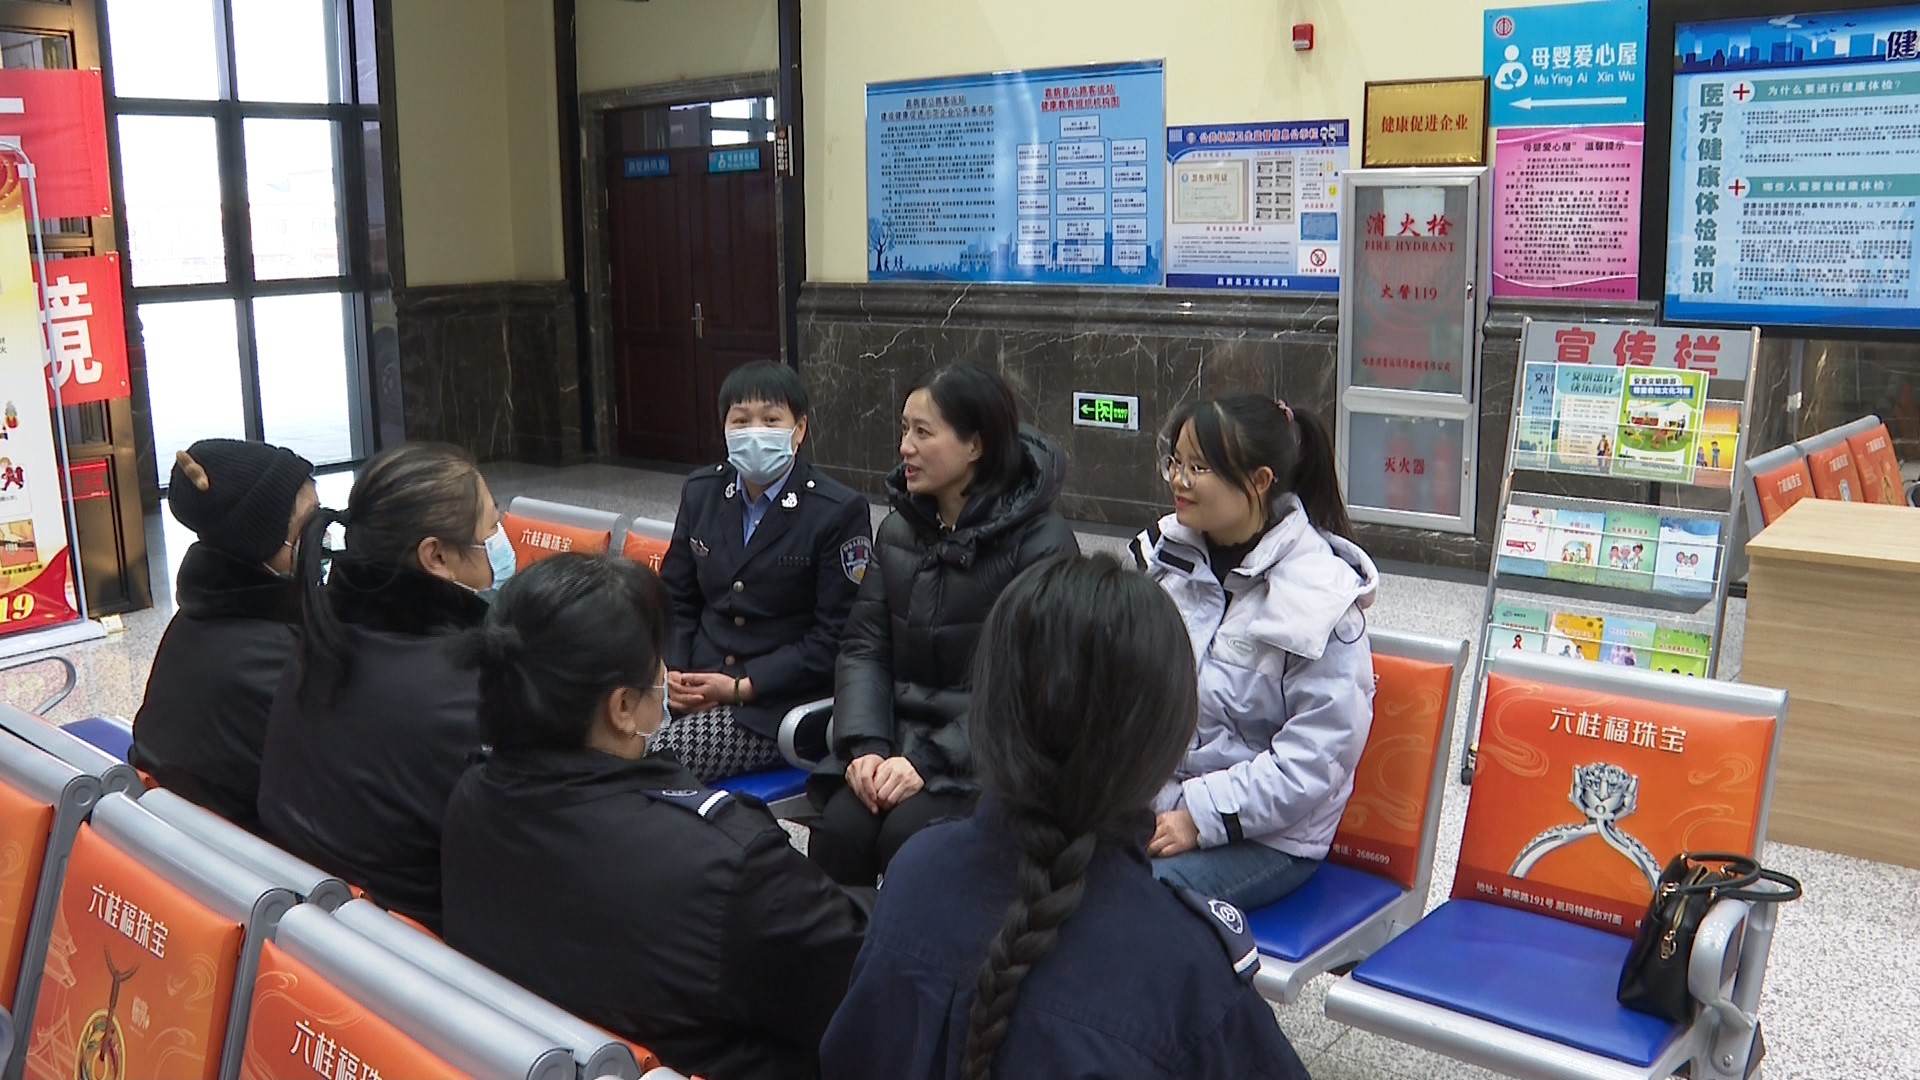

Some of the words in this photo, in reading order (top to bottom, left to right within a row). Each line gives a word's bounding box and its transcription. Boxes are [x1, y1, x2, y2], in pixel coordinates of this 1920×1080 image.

[1531, 42, 1638, 70] 母婴爱心屋
[1887, 30, 1918, 61] 健
[1534, 74, 1549, 85] Mu
[1551, 73, 1573, 86] Ying
[1577, 71, 1588, 83] Ai
[1598, 71, 1614, 82] Xin
[1618, 70, 1636, 82] Wu
[1381, 114, 1469, 133] 健康促进企业
[1585, 141, 1625, 152] 温馨提示
[1693, 83, 1724, 294] 医疗健康体检常识
[1366, 212, 1454, 237] 消火栓
[1365, 240, 1391, 251] FIRE
[1395, 241, 1455, 252] HYDRANT
[1381, 284, 1438, 300] 火警119
[1555, 327, 1721, 376] 宣传栏
[1384, 457, 1425, 475] 灭火器
[520, 529, 573, 552] 六桂福珠宝
[1549, 707, 1687, 754] 六桂福珠宝
[87, 884, 170, 960] 六桂福珠宝
